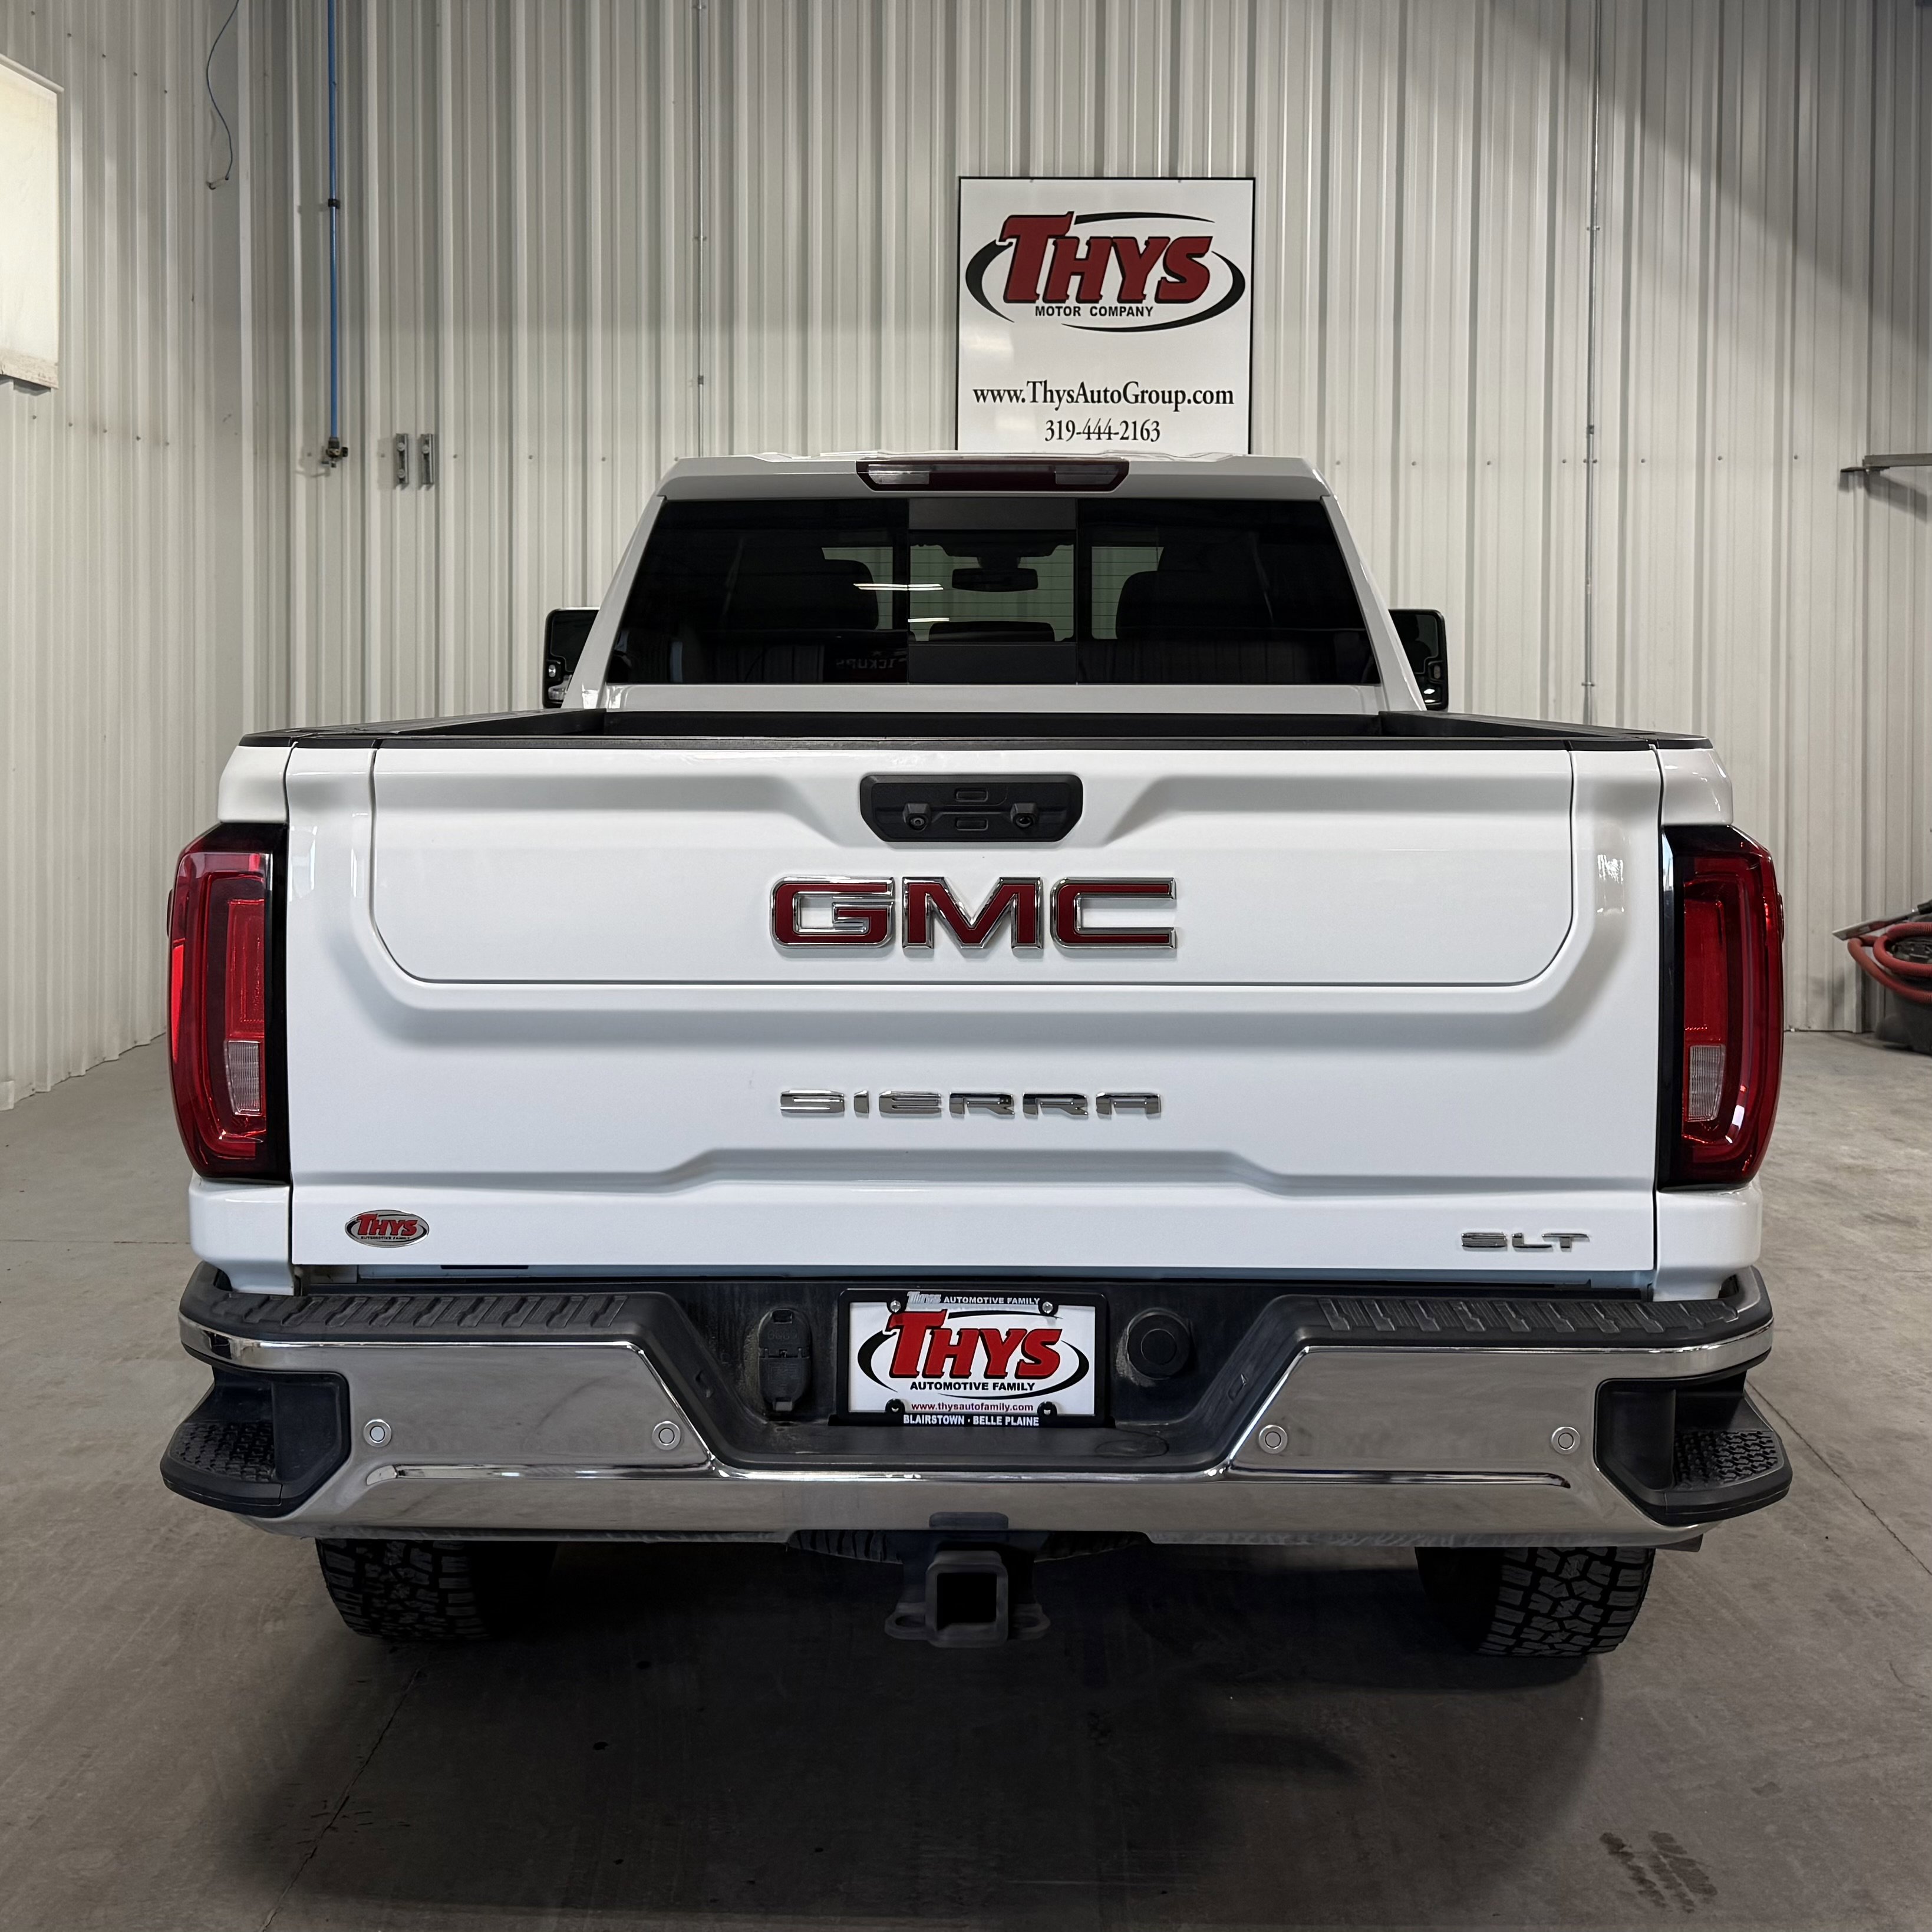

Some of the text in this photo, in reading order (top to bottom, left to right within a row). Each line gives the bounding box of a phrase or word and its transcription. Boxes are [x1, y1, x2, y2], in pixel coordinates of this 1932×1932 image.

[1000, 211, 1213, 304] THYS
[1035, 305, 1153, 317] MOTOR COMPANY
[972, 380, 1235, 412] www.ThysAutoGroup.com
[1045, 418, 1161, 442] 319-444-2163
[770, 876, 1177, 949] GMC
[780, 1090, 1162, 1119] SIERRA
[356, 1214, 418, 1236] THYS
[1461, 1232, 1590, 1252] SLT
[944, 1296, 1004, 1304] AUTOMOTIVE
[885, 1309, 1062, 1379] THYS
[910, 1382, 1036, 1391] AUTOMOTIVE FAMILY
[911, 1402, 1033, 1412] www.thysautofamily.com
[903, 1415, 1039, 1426] BLAIRSTOWN BELLE PLAINE
